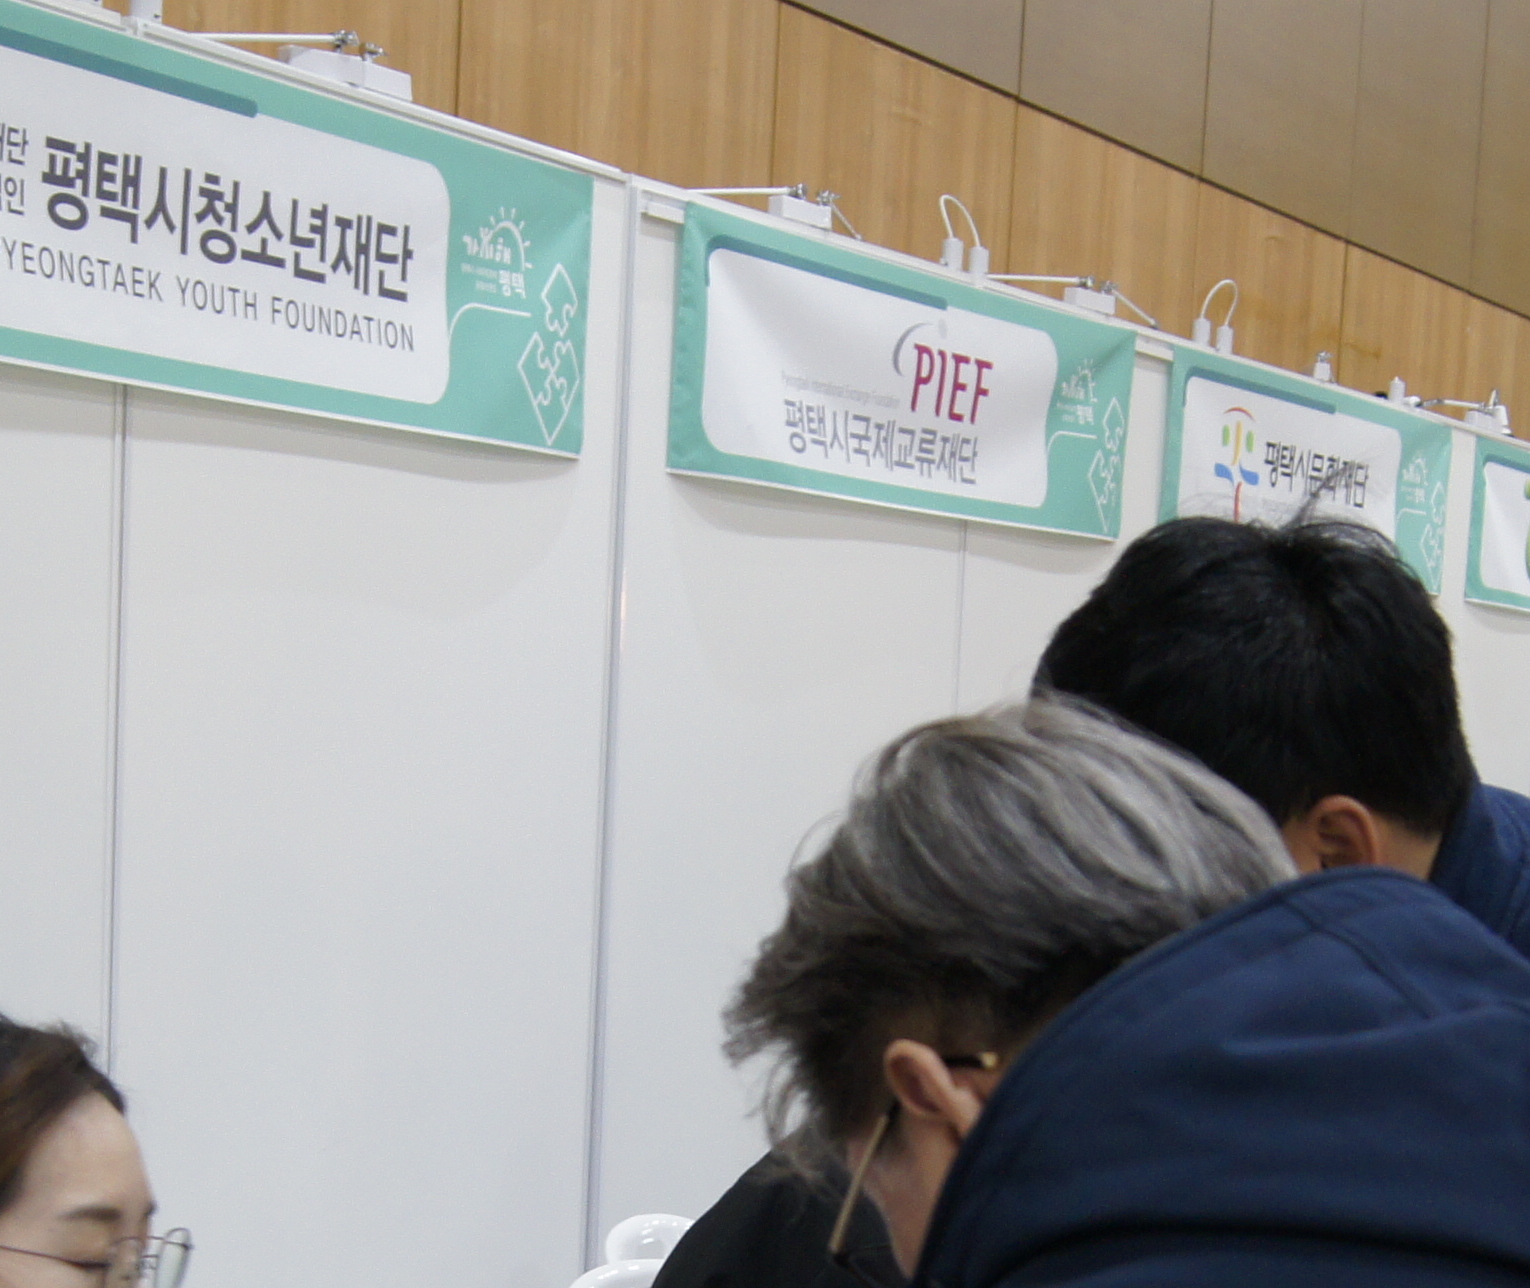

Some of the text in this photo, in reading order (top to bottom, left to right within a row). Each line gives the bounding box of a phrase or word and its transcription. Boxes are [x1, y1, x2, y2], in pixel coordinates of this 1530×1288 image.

[41, 135, 414, 303] 평택시청소년재단
[175, 274, 259, 321] YOUTH
[271, 295, 415, 352] FOUNDATION
[910, 342, 994, 425] PIEF
[783, 398, 978, 485] 평택시국제교류재단
[1264, 441, 1369, 508] 평택시문화재단
